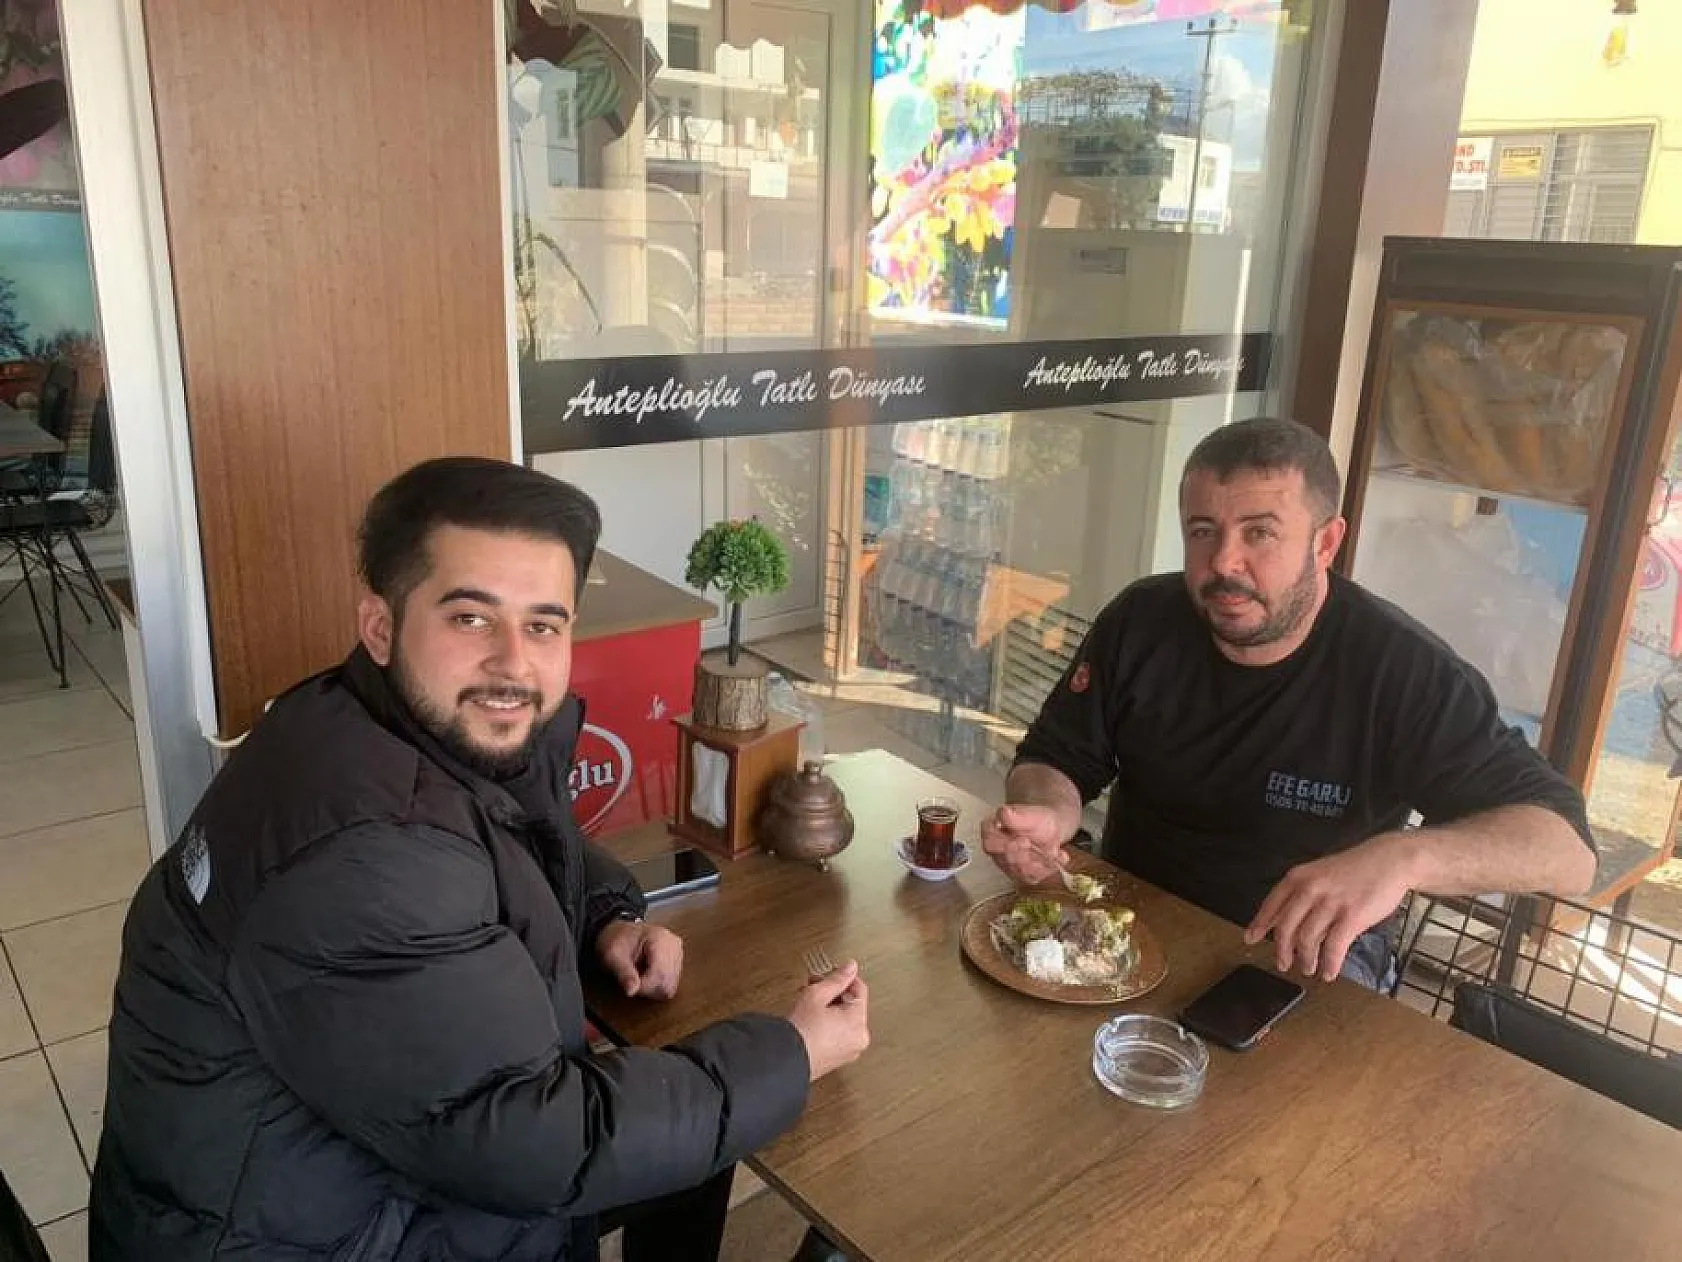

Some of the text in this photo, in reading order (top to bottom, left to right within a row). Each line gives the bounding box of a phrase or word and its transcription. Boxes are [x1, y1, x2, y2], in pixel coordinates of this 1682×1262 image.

[562, 366, 926, 424] Anteplioğlu Tatlı Dünyası
[1023, 355, 1131, 392] Anteplioğlu
[1137, 349, 1178, 380] Tatlı
